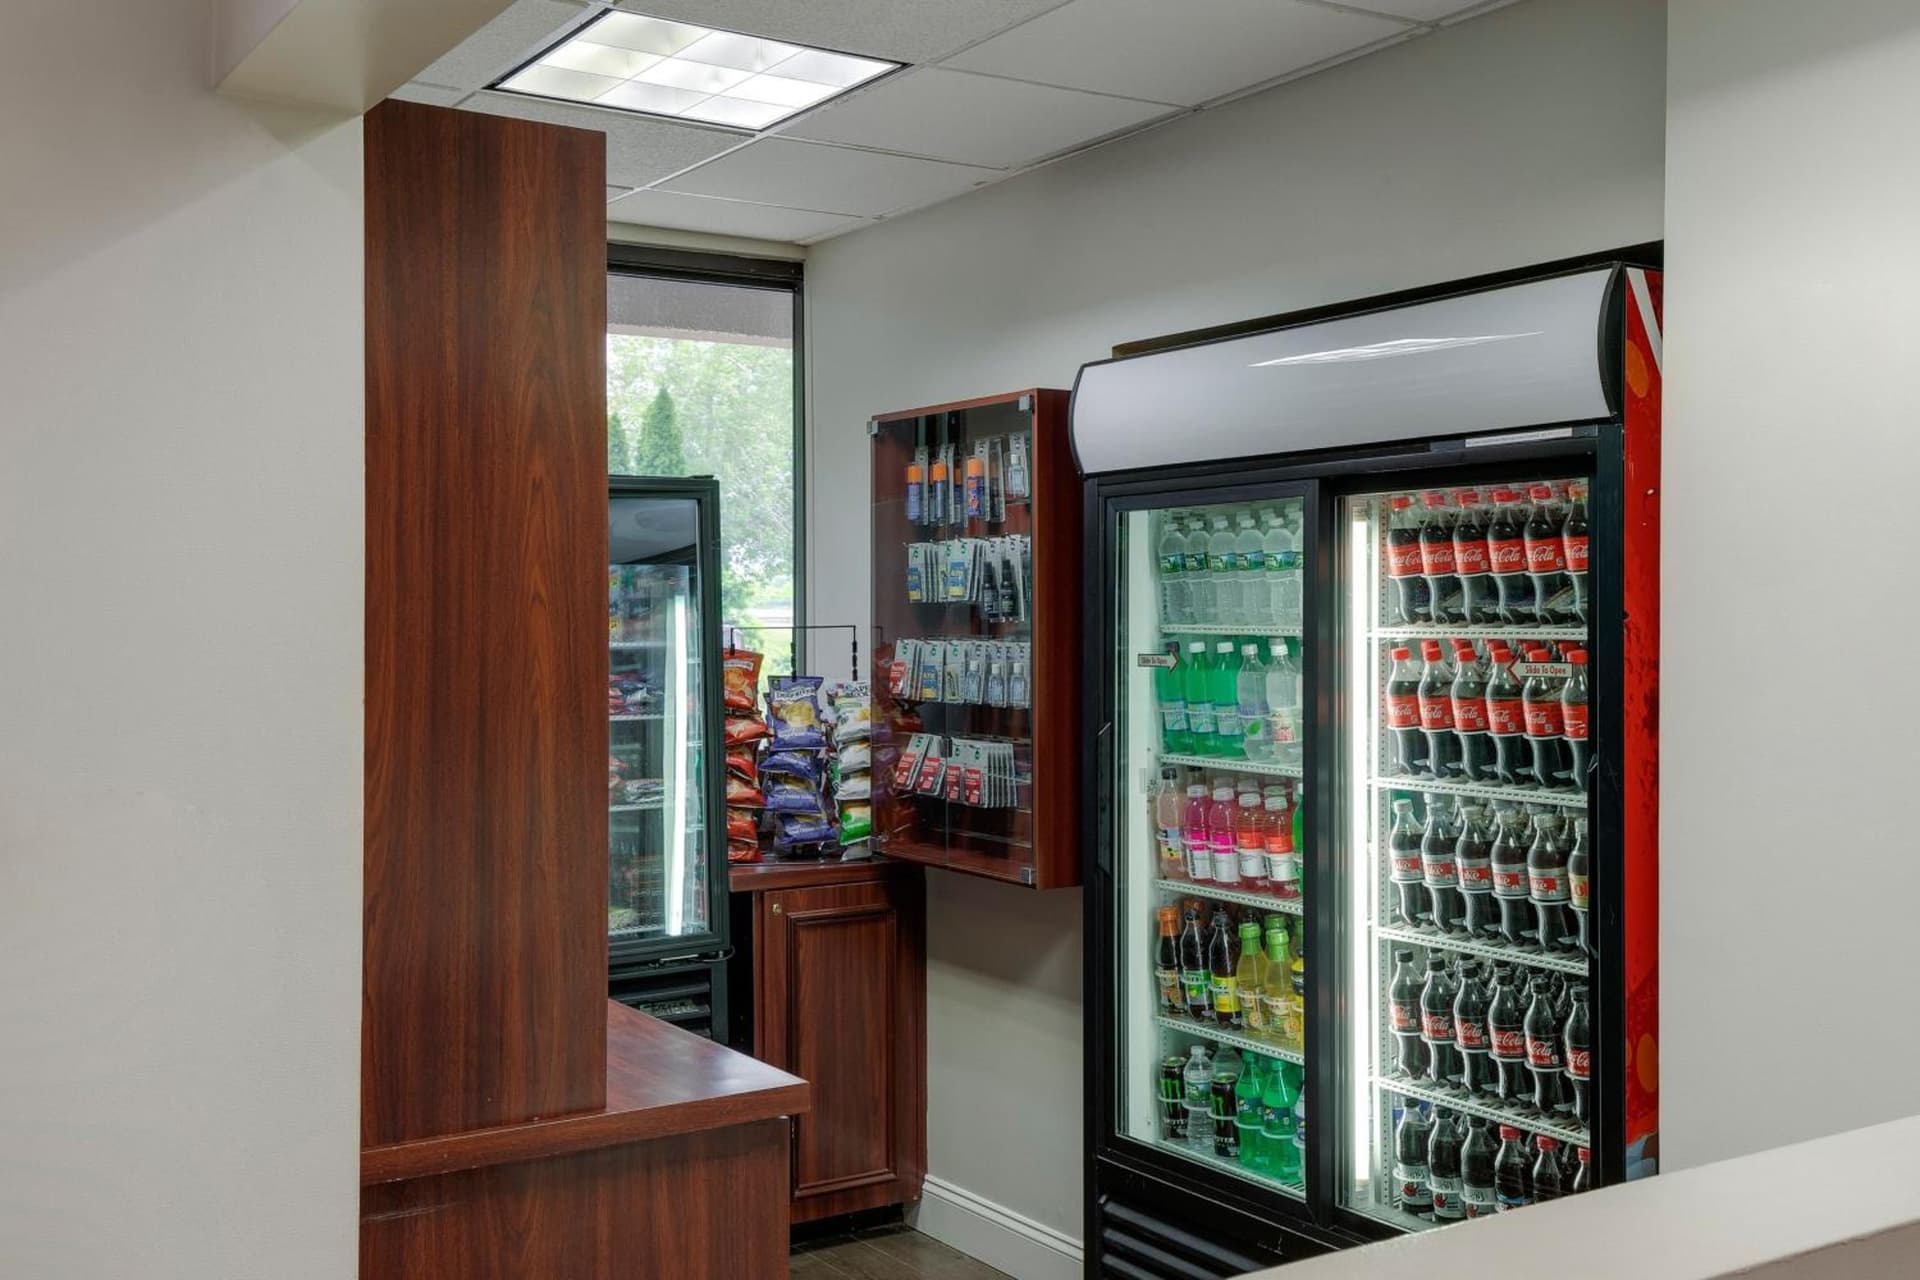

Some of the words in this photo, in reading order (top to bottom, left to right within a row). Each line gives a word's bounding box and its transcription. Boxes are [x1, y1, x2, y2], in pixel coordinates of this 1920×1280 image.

[1525, 665, 1540, 674] Slide
[1541, 665, 1549, 674] To
[1549, 665, 1566, 676] Open
